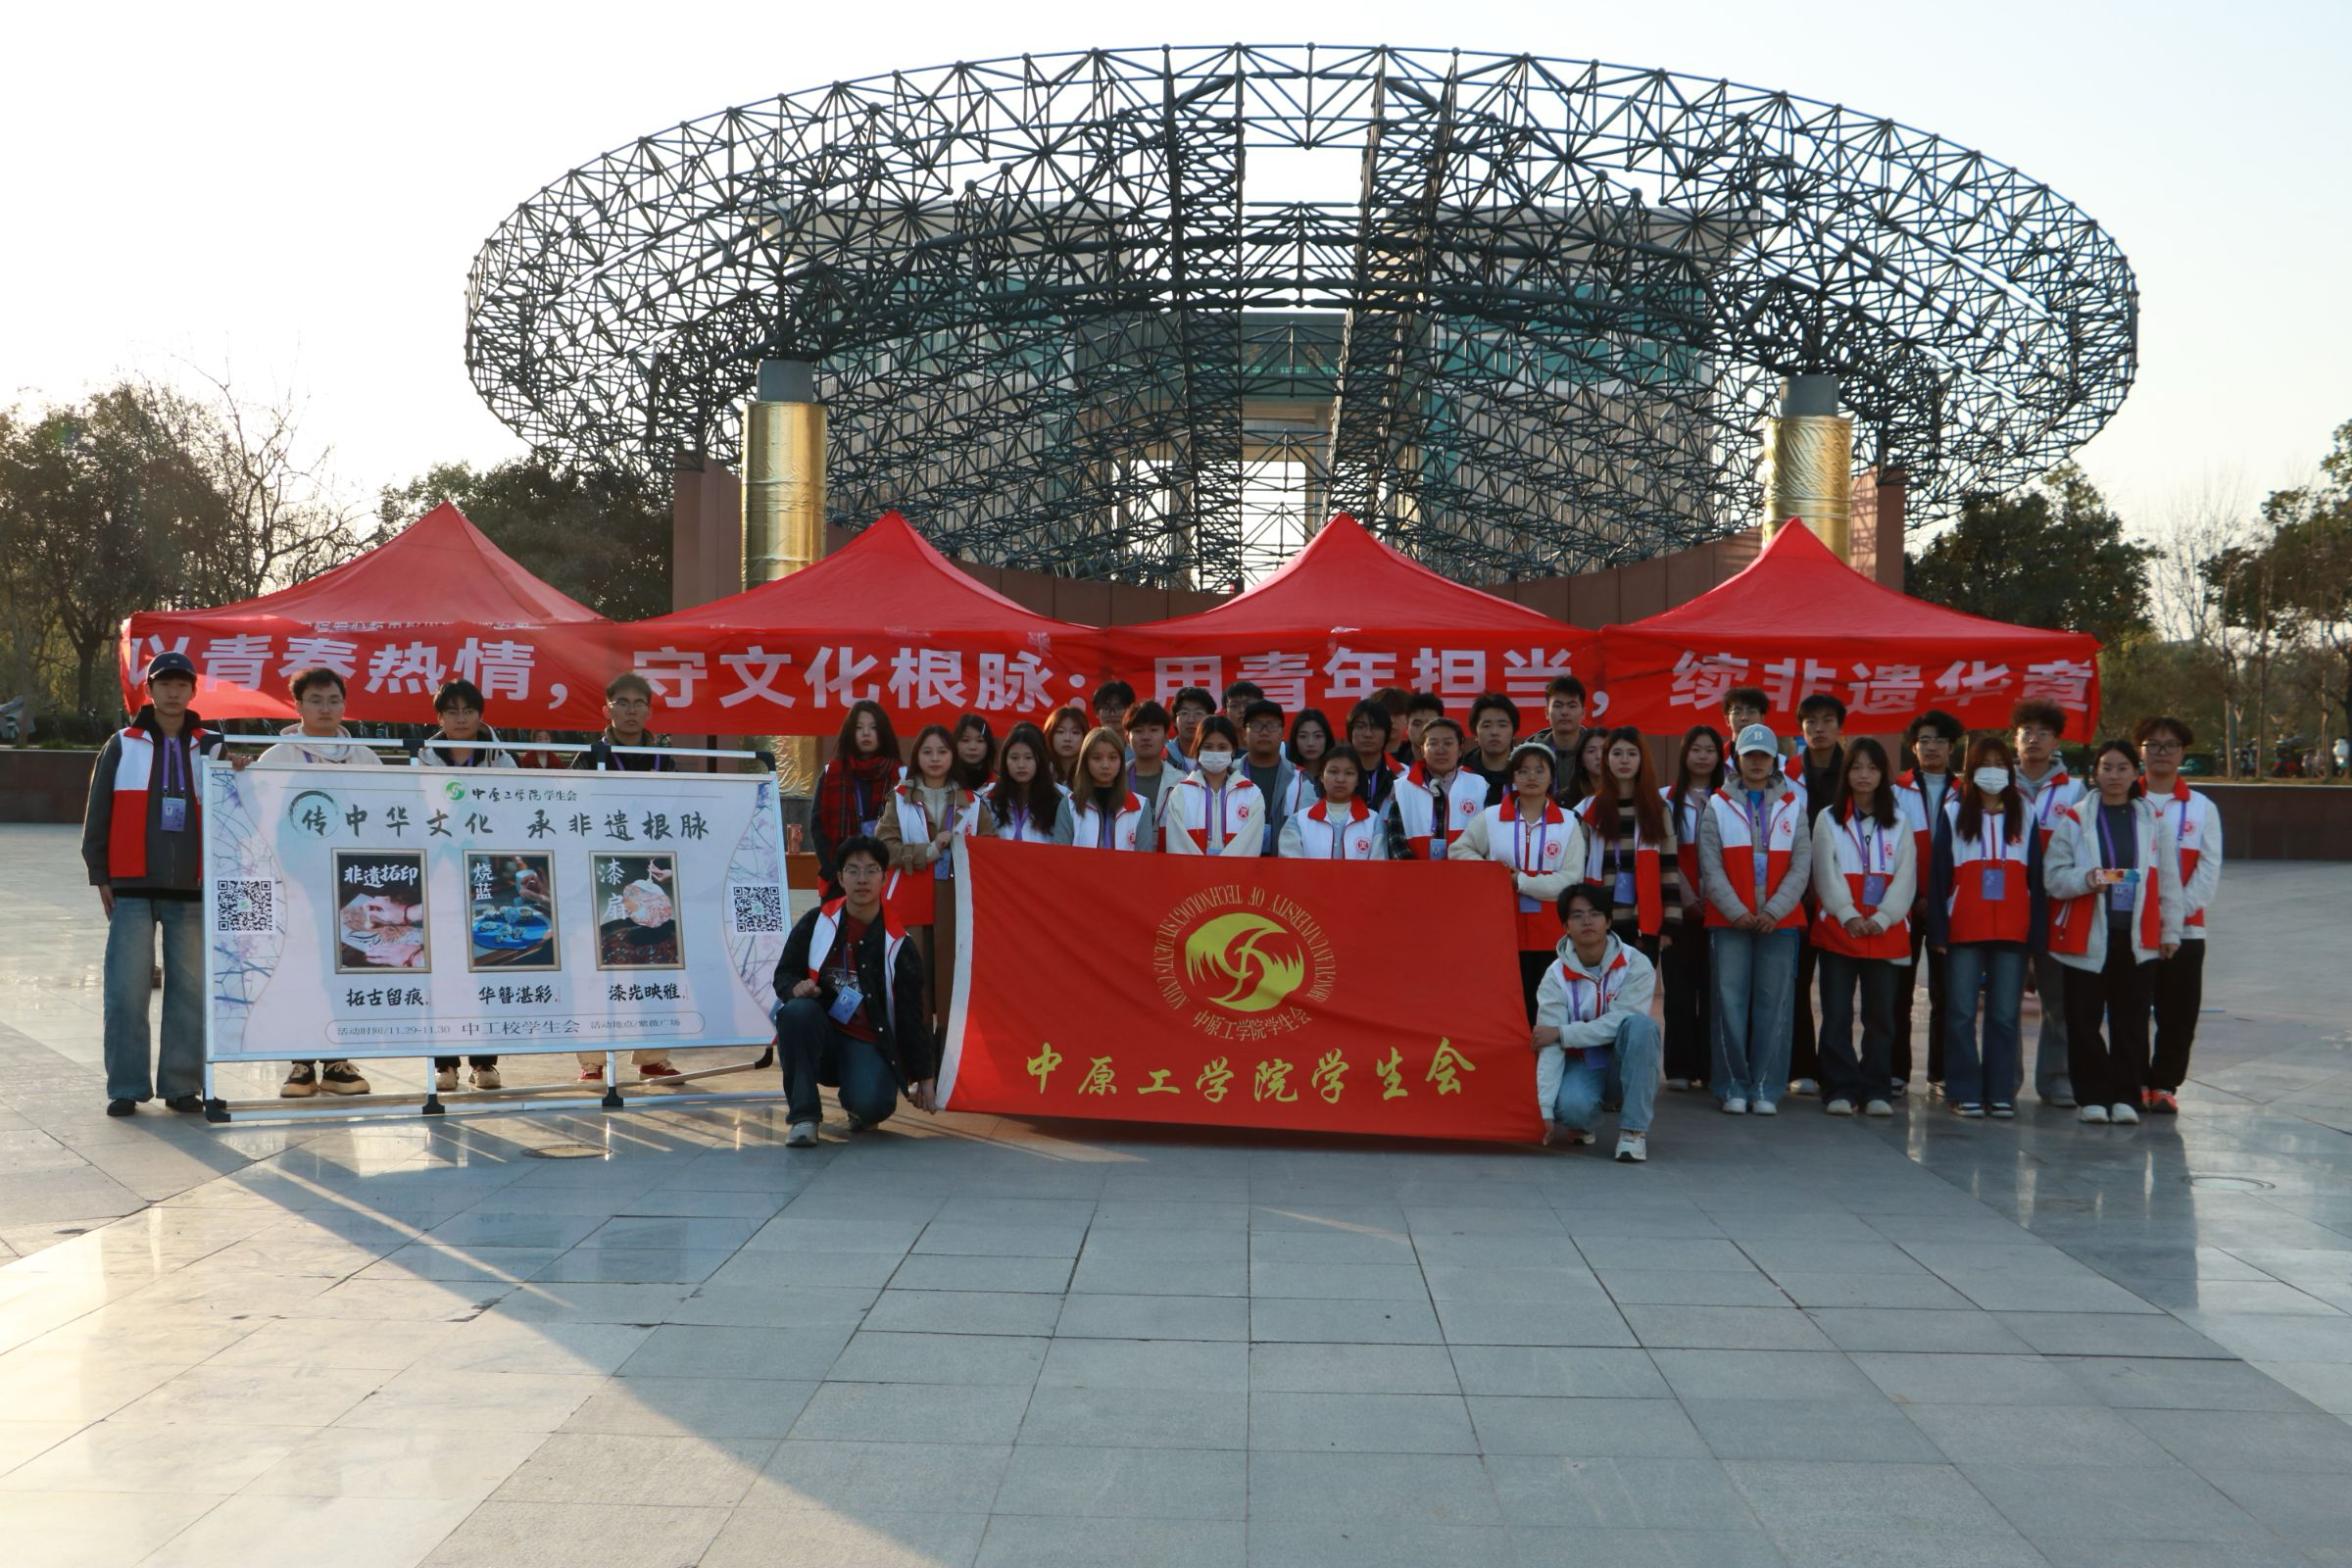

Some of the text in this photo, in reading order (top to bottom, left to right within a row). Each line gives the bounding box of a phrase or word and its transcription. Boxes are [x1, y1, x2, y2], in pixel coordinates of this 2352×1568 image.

[1669, 650, 2093, 714] 续非遗华章
[1753, 731, 1763, 741] B
[301, 804, 710, 842] 传中华文化 承非遗根脉
[343, 864, 420, 889] 非遗拓印
[473, 862, 493, 902] 烧蓝
[597, 858, 627, 921] 漆扇
[1167, 884, 1244, 927] TECHNOLOGY
[1248, 886, 1266, 906] OF
[1268, 894, 1330, 951] UNIVERSITY
[346, 987, 424, 1006] 拓古留痕
[609, 982, 680, 1002] 漆光映雅
[462, 1019, 580, 1037] 中工校学生会
[1193, 1006, 1313, 1042] 中原工学院学生会
[1026, 1037, 1477, 1104] 中原工学院学生会
